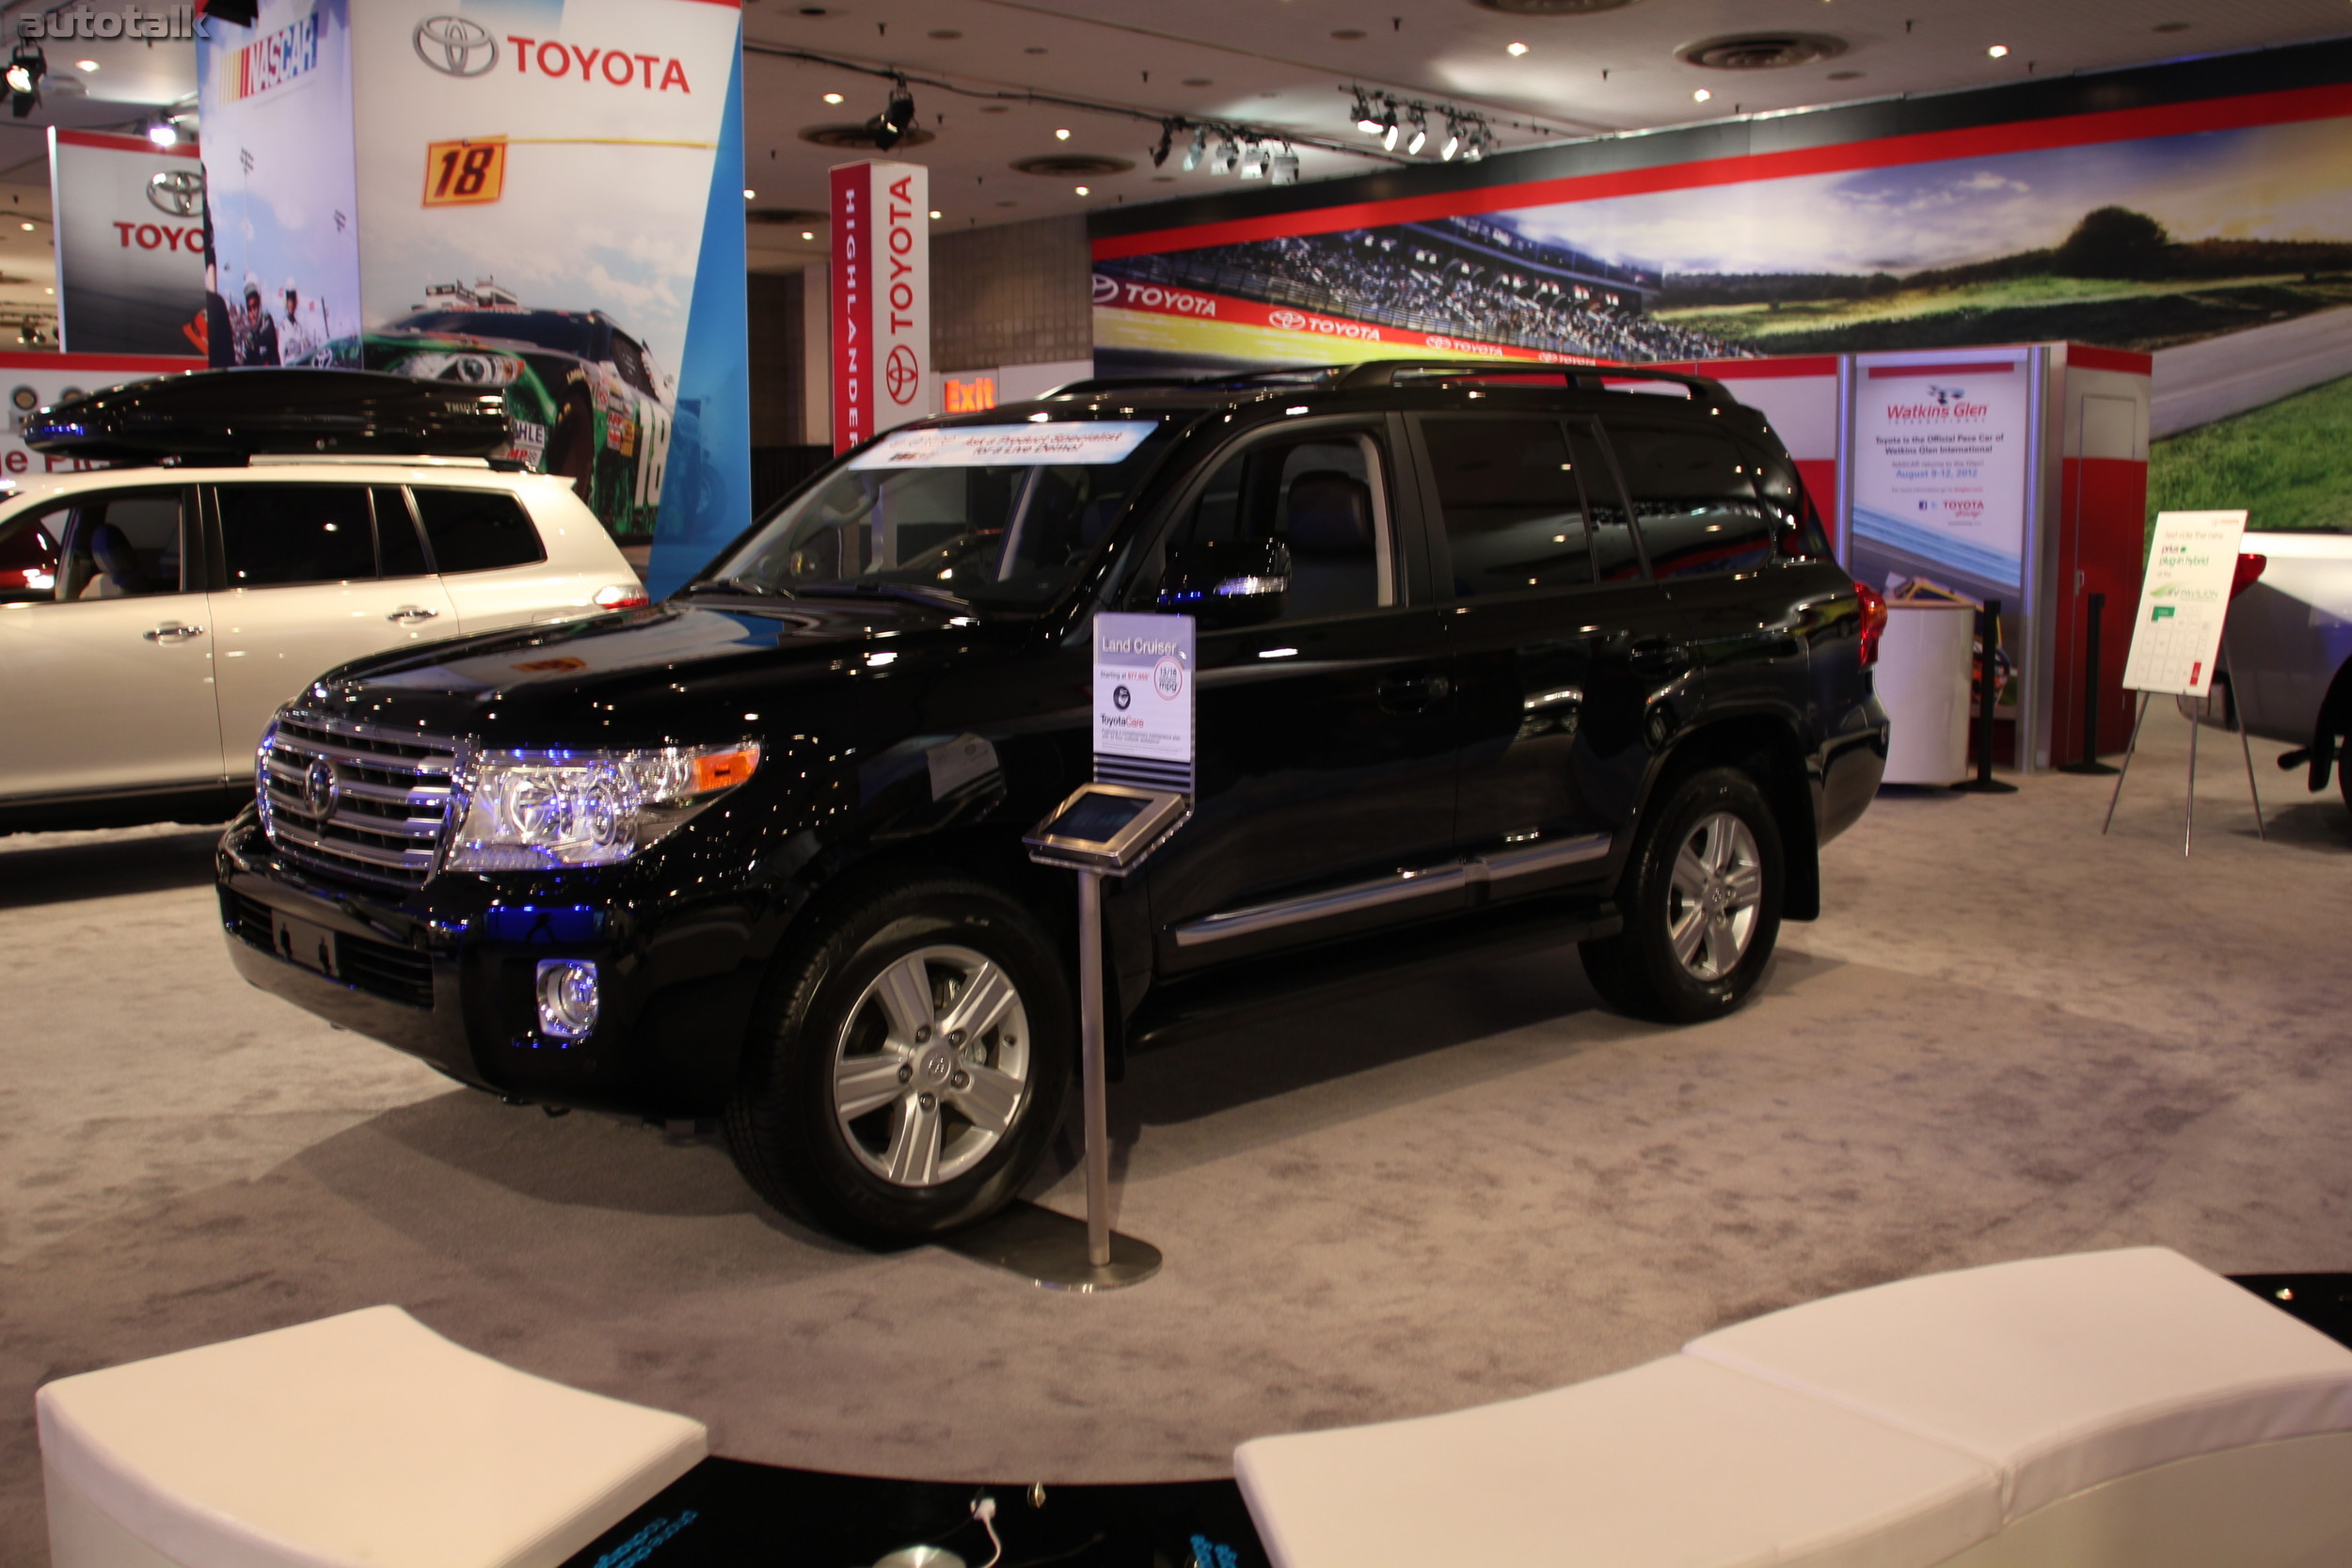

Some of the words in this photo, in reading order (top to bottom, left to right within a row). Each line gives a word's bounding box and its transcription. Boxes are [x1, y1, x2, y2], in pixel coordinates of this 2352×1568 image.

[246, 19, 318, 94] NASCAR
[507, 35, 691, 94] TOYOTA
[434, 146, 495, 198] 18
[113, 221, 205, 253] TOYO
[890, 175, 913, 335] TOYOTA
[1125, 282, 1216, 317] TOYOTA
[846, 189, 860, 450] HIGHLANDER
[1309, 316, 1381, 341] TOYOTA
[1454, 341, 1504, 357] TOYOTA
[944, 377, 995, 413] Exit
[1886, 404, 1949, 420] Watkins
[1953, 402, 1988, 418] Glen
[1875, 436, 1901, 446] Toyota
[1902, 436, 1910, 444] is
[1912, 435, 1925, 444] the
[1927, 434, 1956, 444] Official
[1958, 433, 1977, 443] Pace
[1979, 432, 1993, 442] Car
[1995, 431, 2005, 441] of
[1885, 446, 1917, 455] Watkins
[1919, 446, 1938, 455] Glen
[1940, 445, 1993, 454] International
[634, 398, 672, 508] 18
[1896, 469, 1928, 481] August
[1956, 469, 1979, 479] 2012
[1943, 500, 1984, 511] TOYOTA
[1102, 636, 1131, 654] Land
[1134, 637, 1178, 656] Cruiser
[1159, 681, 1177, 693] mpg
[1101, 713, 1144, 728] ToyotaCare
